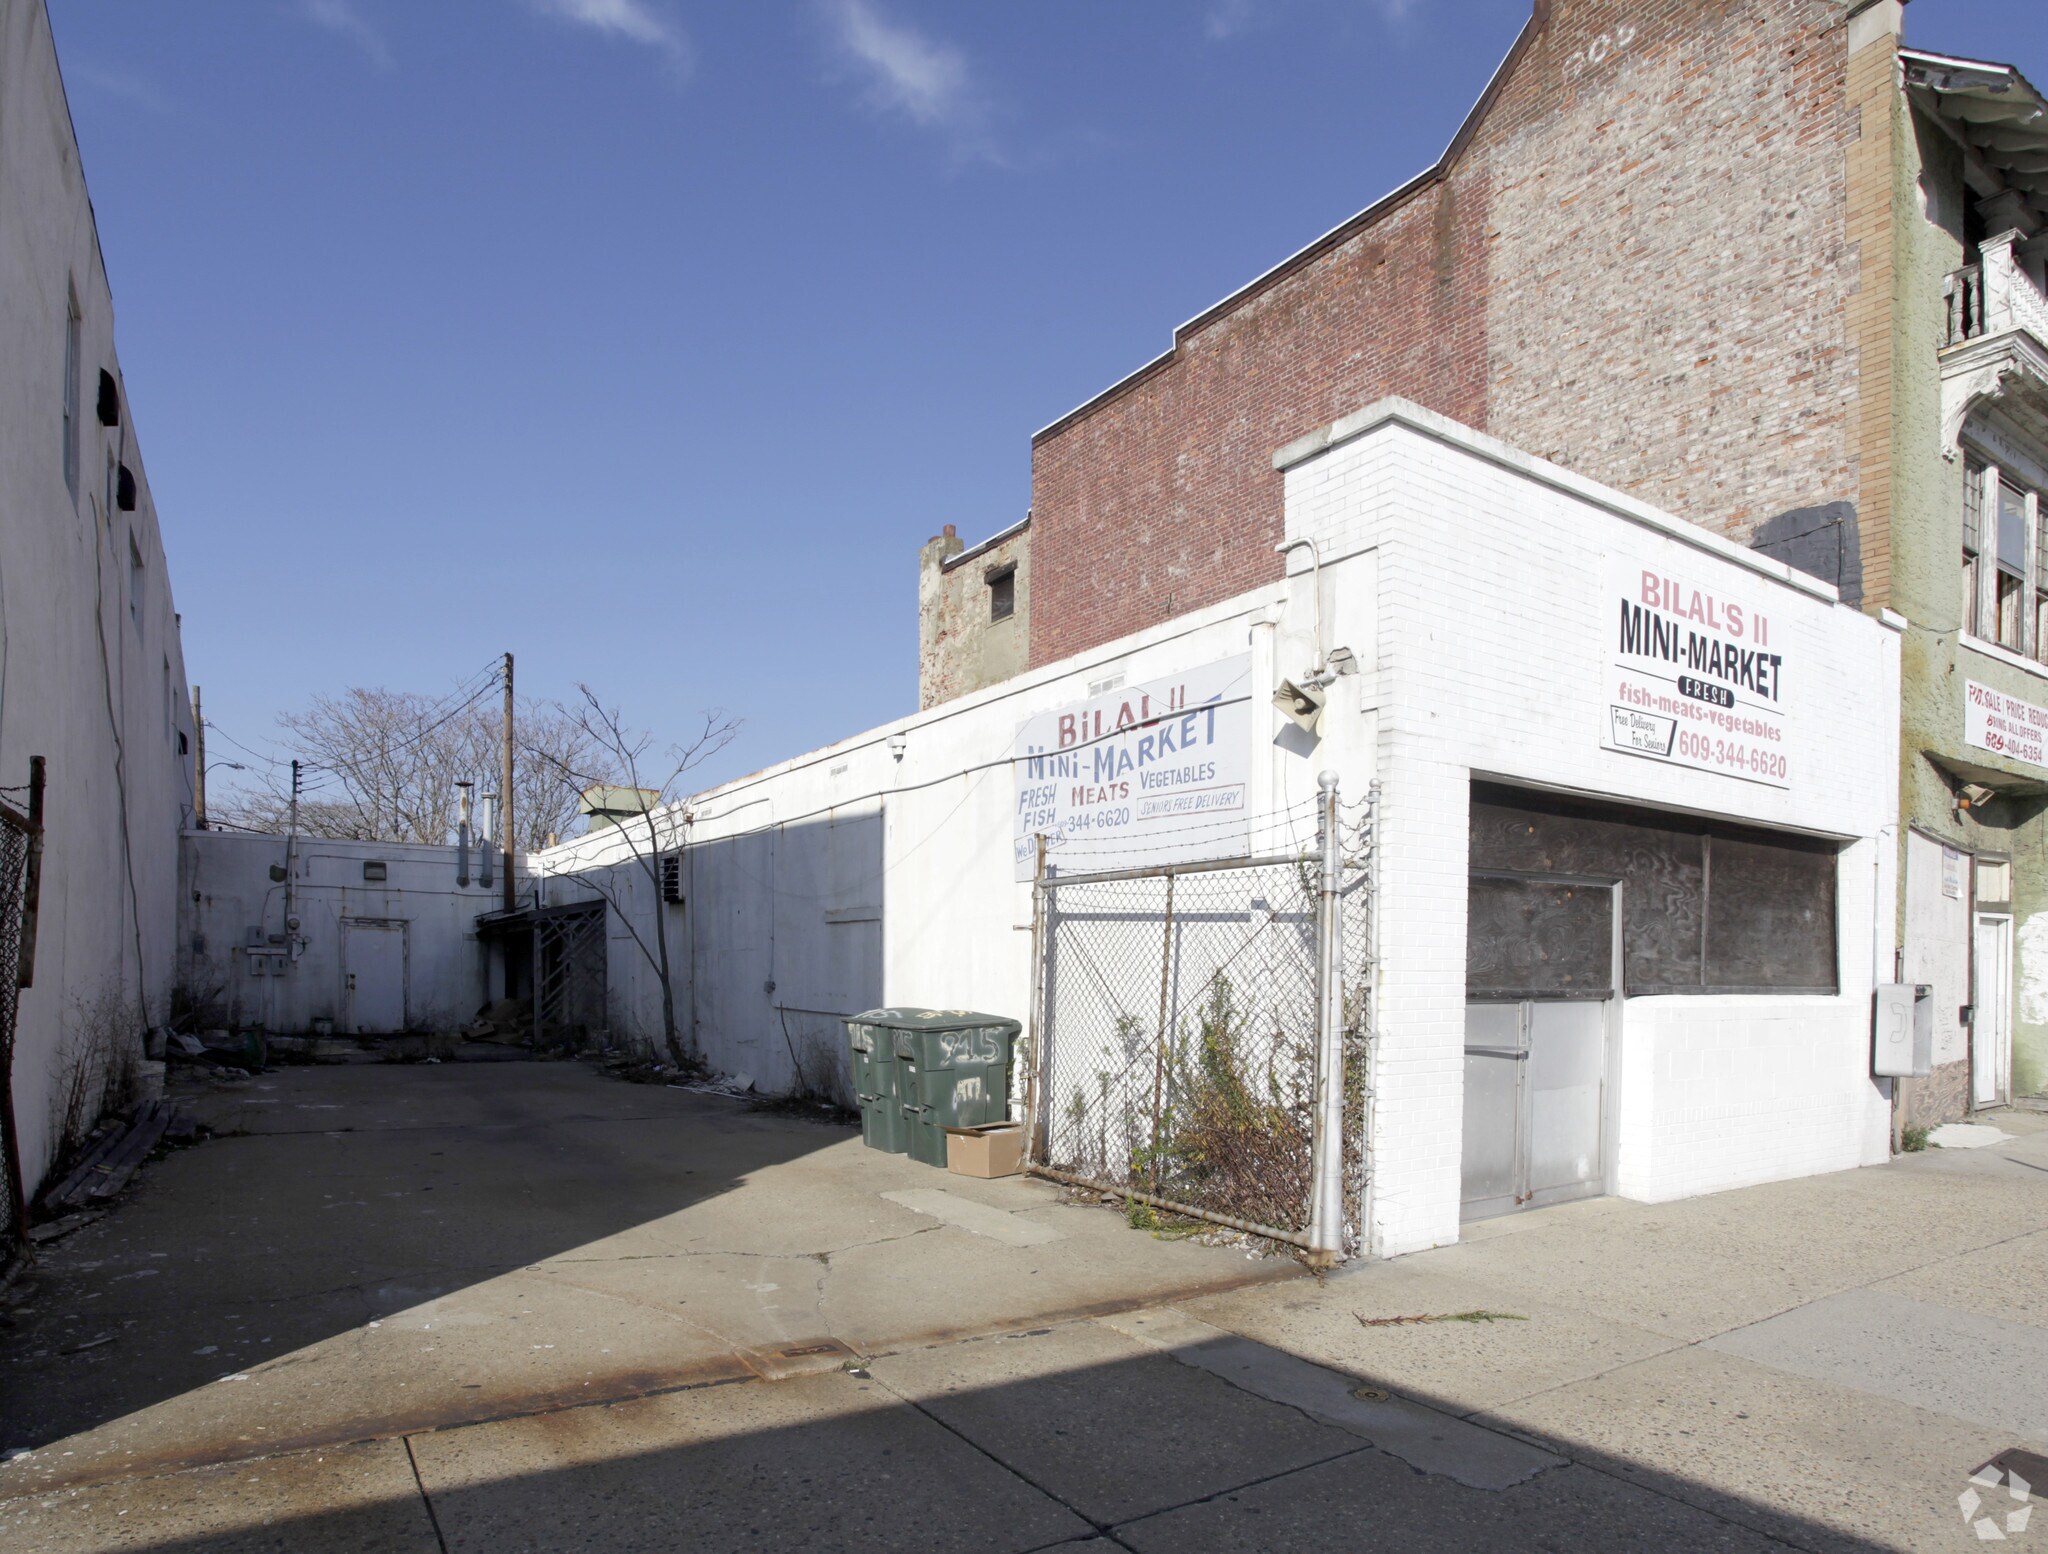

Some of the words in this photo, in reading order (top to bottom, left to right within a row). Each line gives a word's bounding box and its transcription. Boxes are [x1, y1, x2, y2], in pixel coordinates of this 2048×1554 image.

[1641, 570, 1744, 638] BILAL'S
[1620, 597, 1782, 703] MINI-MARKET
[1685, 678, 1728, 706] FRESH
[1615, 709, 1629, 727] Free
[1630, 713, 1656, 736] Delivery
[1619, 681, 1782, 743] fish-meats-vegetables
[1632, 731, 1643, 746] For
[1644, 733, 1666, 752] Seniors
[2020, 725, 2042, 743] OFFERS
[1679, 730, 1787, 779] 609-344-6620
[1140, 761, 1216, 790] VEGETABLES
[1018, 783, 1057, 815] FRESH
[1072, 781, 1130, 807] MEATS
[1141, 800, 1172, 816] SENIORS
[1173, 795, 1194, 811] FREE
[1194, 791, 1240, 809] DELIVERY
[1023, 807, 1056, 832] FISH
[939, 1026, 1003, 1067] 915
